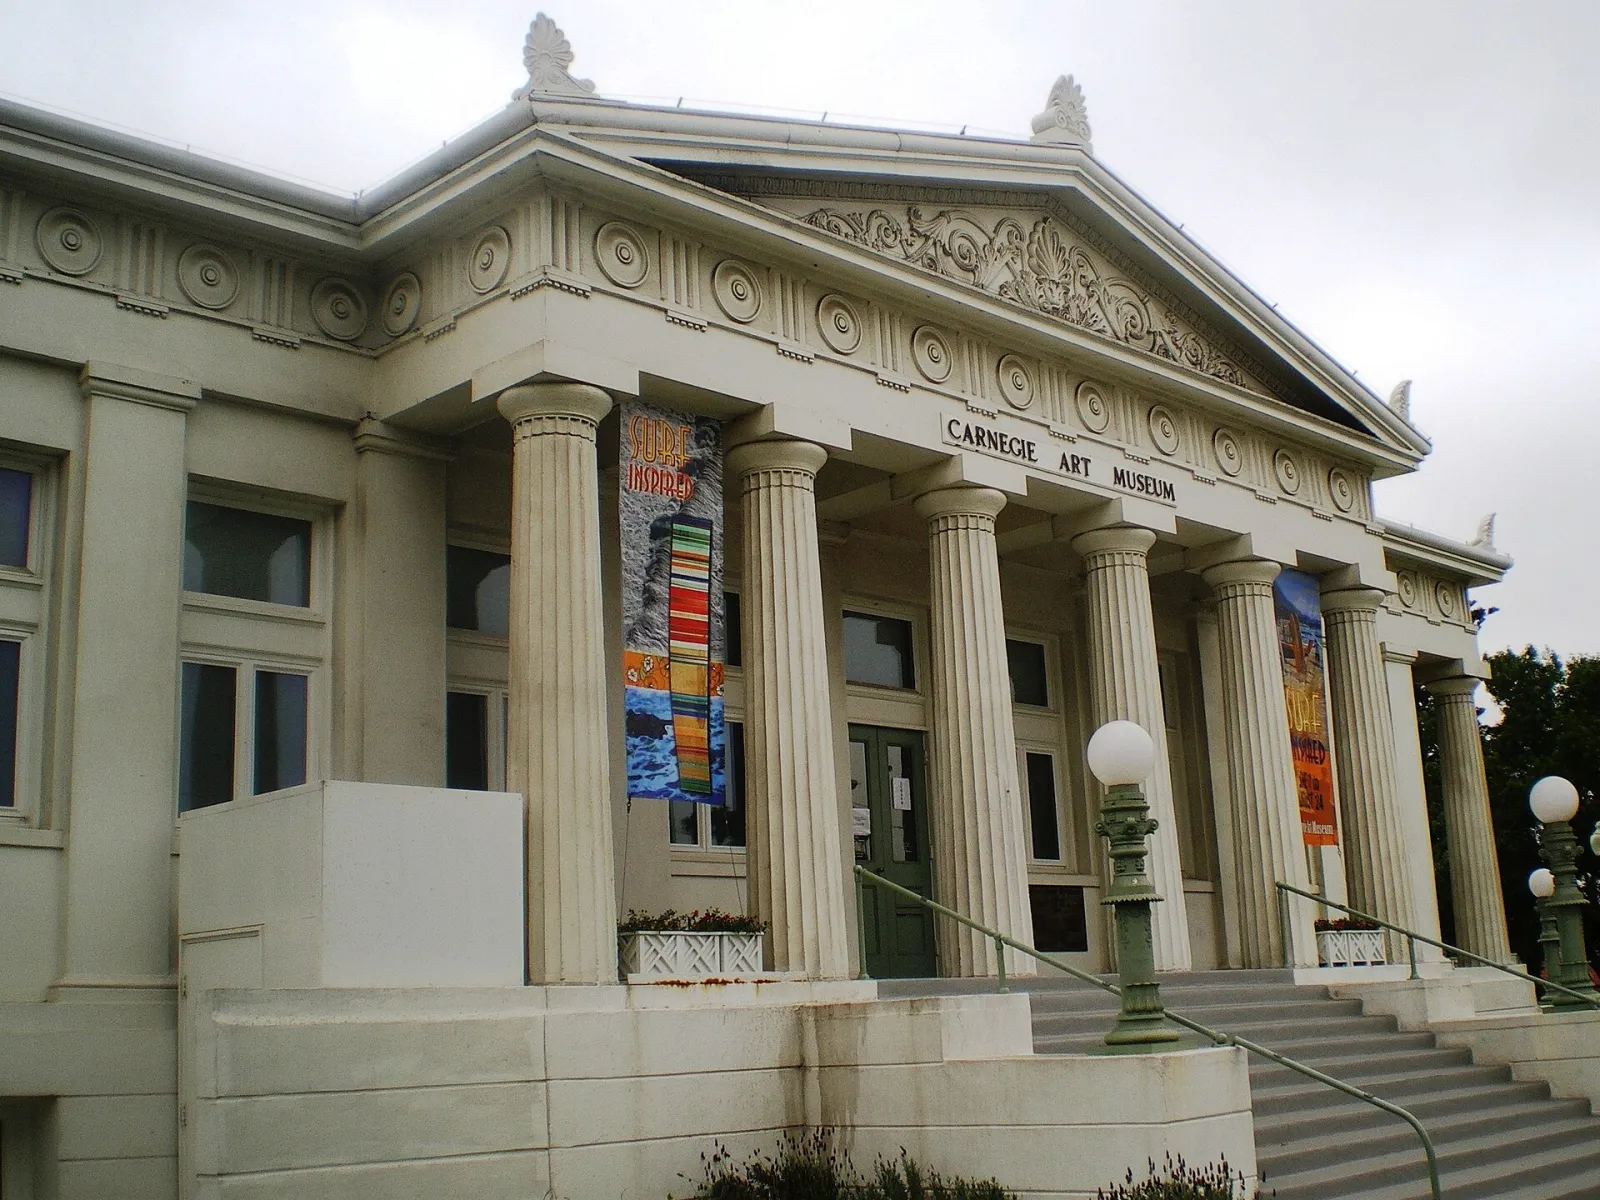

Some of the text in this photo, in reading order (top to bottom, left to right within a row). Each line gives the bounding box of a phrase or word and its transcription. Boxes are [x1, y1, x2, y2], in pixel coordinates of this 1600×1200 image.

[628, 414, 692, 468] SURF
[947, 418, 1176, 502] CARNEGIE ART MUSEUM
[627, 463, 694, 501] INSPIRED
